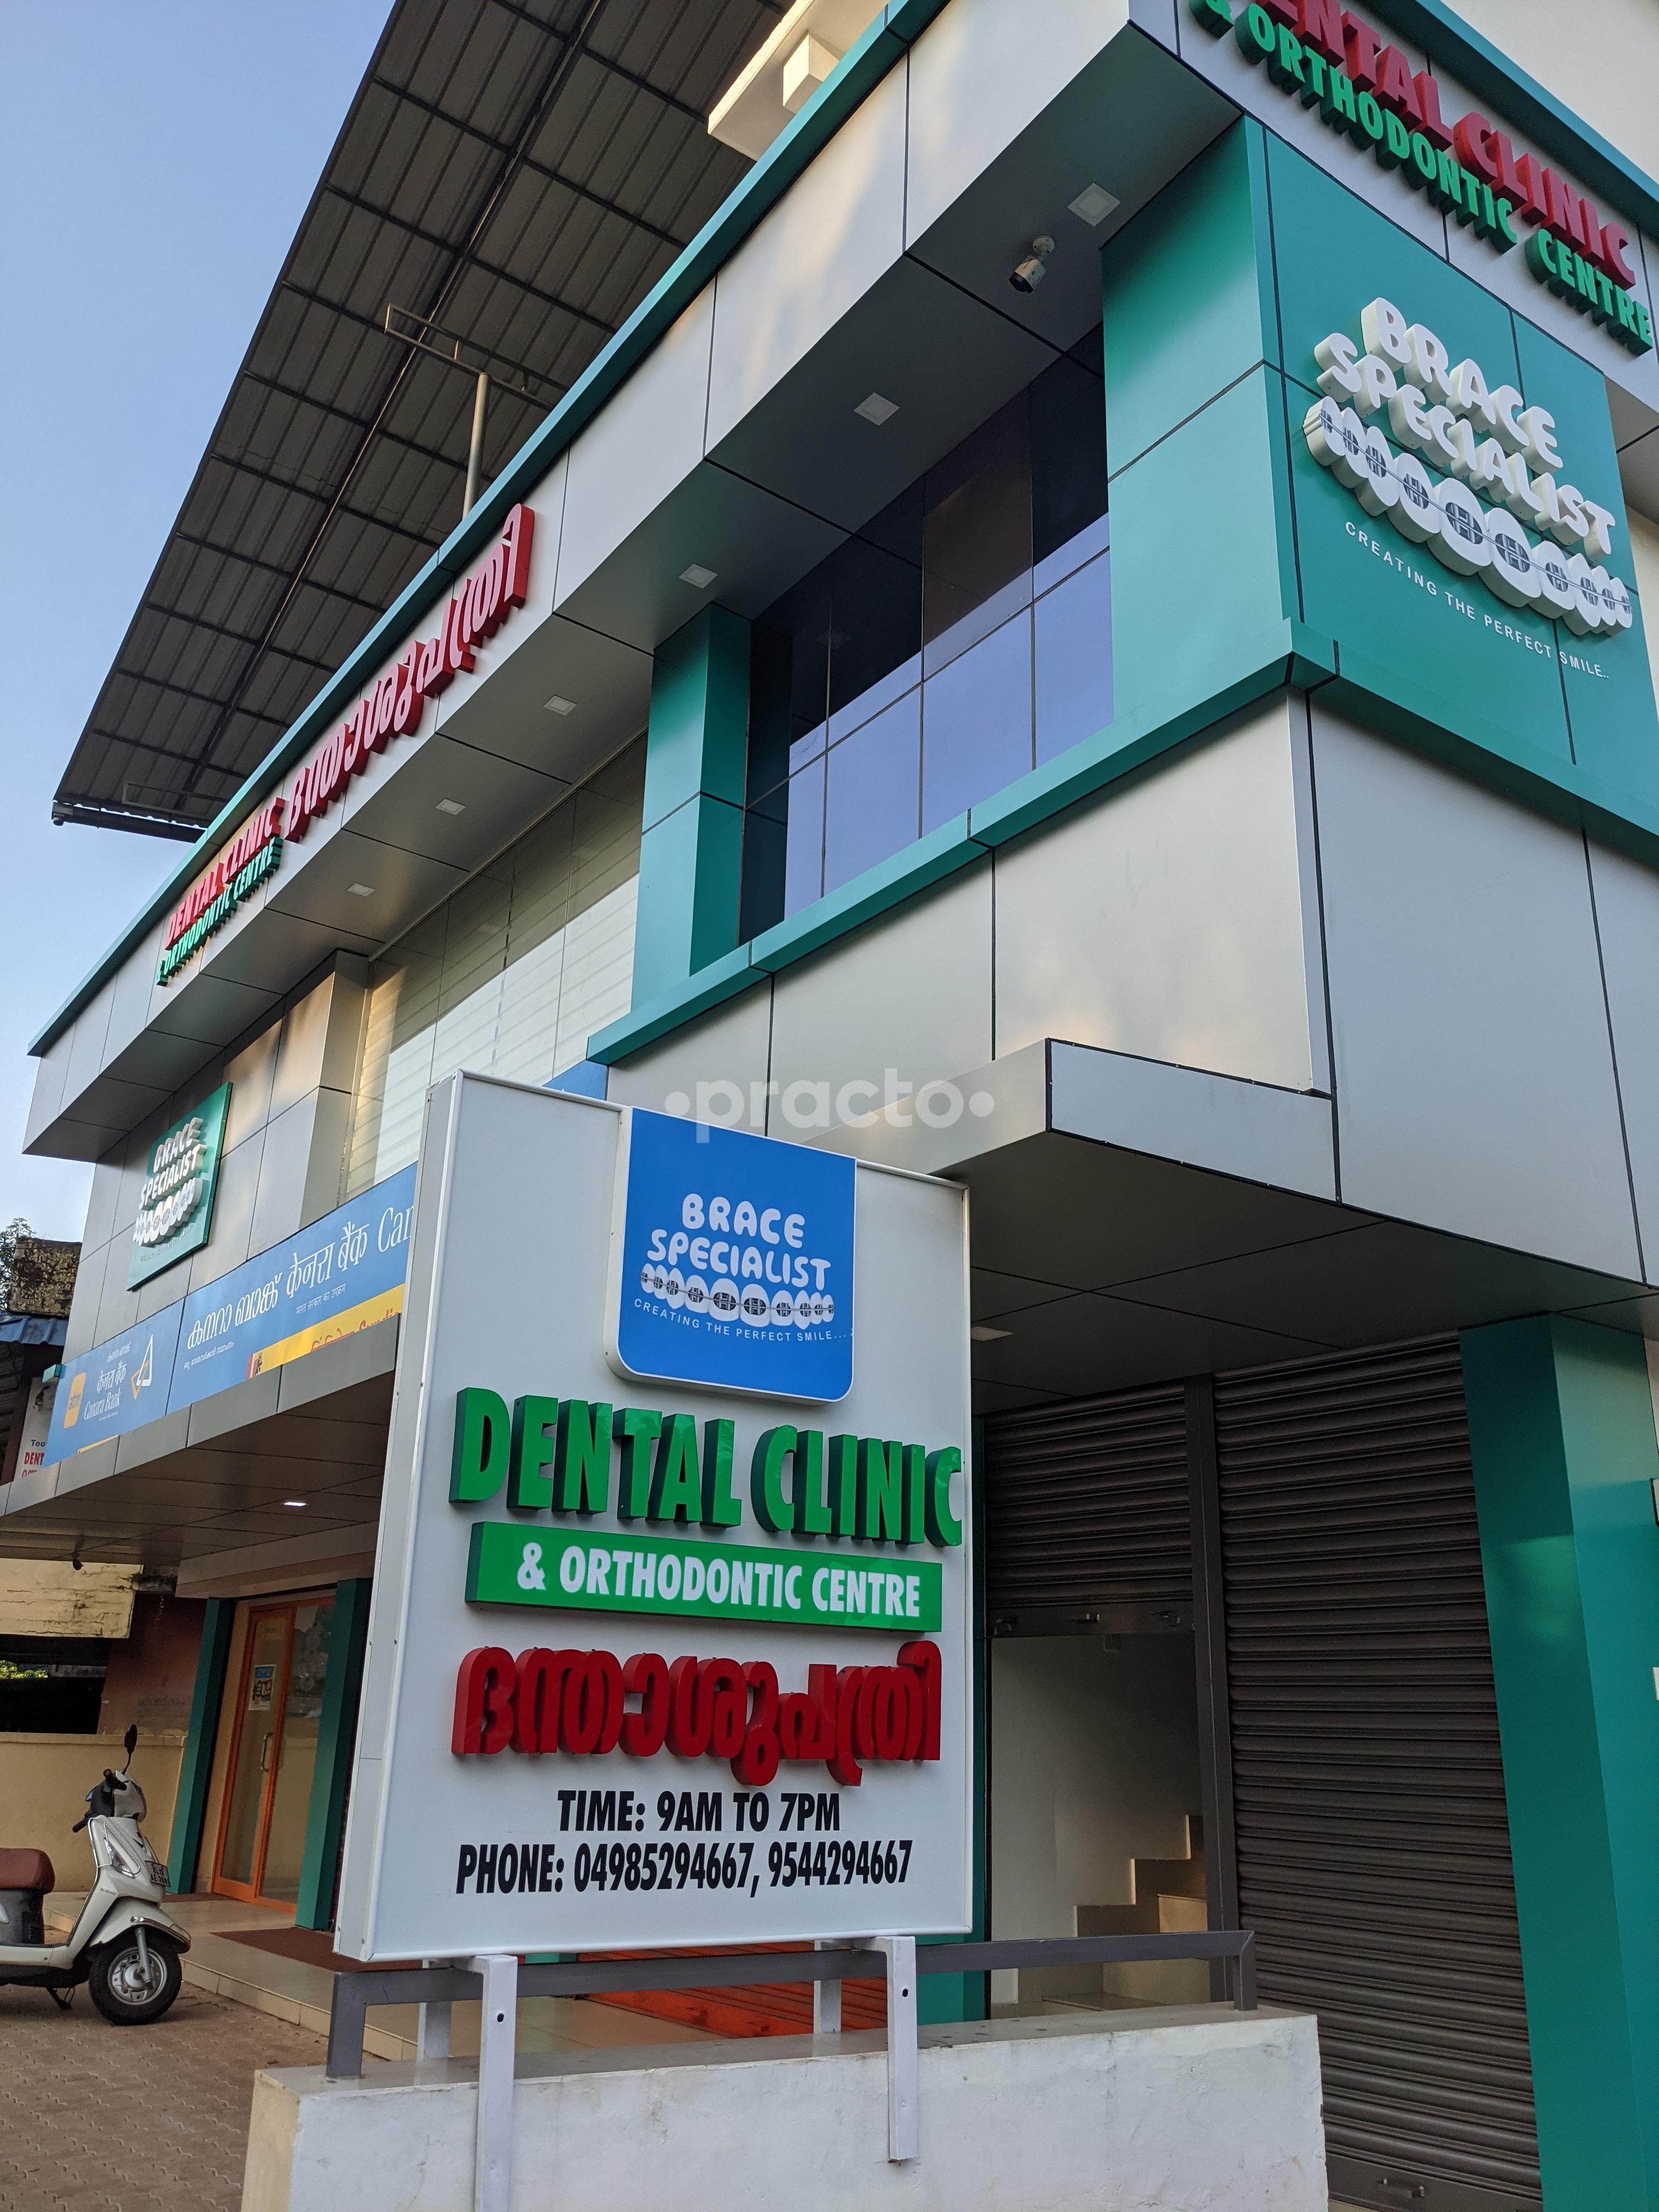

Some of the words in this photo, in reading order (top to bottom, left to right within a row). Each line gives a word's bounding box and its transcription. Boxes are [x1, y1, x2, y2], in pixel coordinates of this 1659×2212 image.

[1235, 3, 1517, 253] ORTHODONTIC
[1525, 228, 1653, 357] CENTRE
[1255, 0, 1453, 151] NTAL
[1453, 111, 1636, 291] CLINIC
[1361, 297, 1563, 473] BRACE
[1314, 332, 1616, 562] SPECIALIST
[1346, 522, 1437, 596] CREATING
[1445, 591, 1476, 620] THE
[1484, 614, 1551, 658] PERFECT
[164, 882, 238, 977] ORTHODONTIC
[234, 837, 284, 902] CENTRE
[165, 862, 224, 951] DENTAL
[222, 797, 285, 884] CLINIC
[139, 1144, 207, 1210] SPECIALIST
[682, 1193, 805, 1249] BRACE
[286, 1242, 336, 1300] केनरा
[337, 1221, 370, 1272] बैंक
[647, 1229, 832, 1291] SPECIALIST
[187, 1304, 233, 1350] കനറാ
[634, 1299, 699, 1329] CREATING
[706, 1322, 730, 1335] THE
[736, 1328, 791, 1341] PERFECT
[84, 1399, 105, 1420] Canara
[104, 1387, 121, 1412] Bank
[97, 1370, 116, 1393] केनरा
[31, 1439, 47, 1447] Too
[448, 1386, 741, 1527] DENTAL
[750, 1424, 962, 1547] CLINIC
[516, 1542, 547, 1592] &
[560, 1545, 802, 1610] ORTHODONTIC
[811, 1567, 921, 1618] CENTRE
[557, 1789, 645, 1833] TIME:
[657, 1791, 723, 1832] 9AM
[732, 1792, 770, 1832] TO
[778, 1792, 841, 1832] 7PM
[455, 1843, 565, 1895] PHONE:
